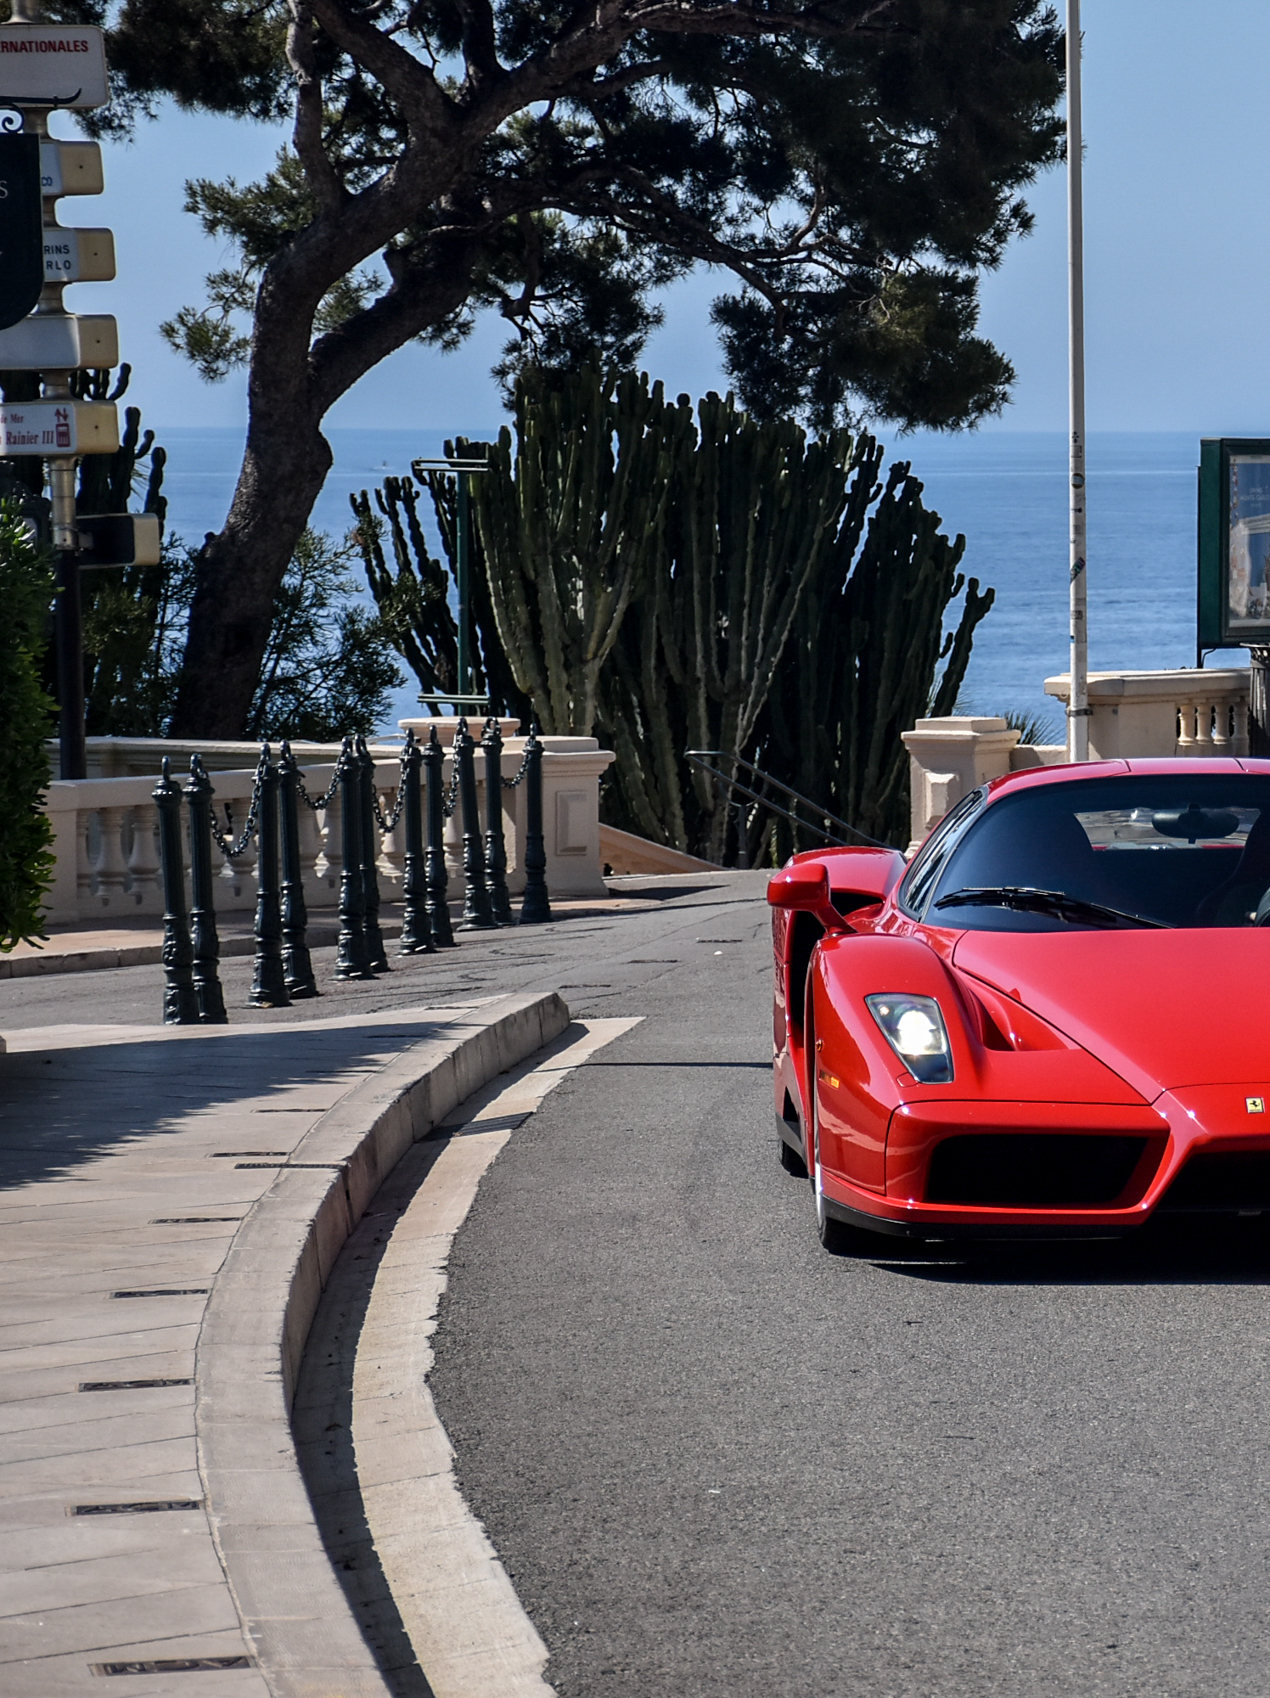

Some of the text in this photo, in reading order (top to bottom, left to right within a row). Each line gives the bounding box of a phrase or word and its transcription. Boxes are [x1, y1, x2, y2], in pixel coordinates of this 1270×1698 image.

[0, 40, 89, 53] RNATIONALES
[44, 244, 70, 255] RINS
[46, 260, 72, 271] RLO
[6, 430, 39, 445] Rainier
